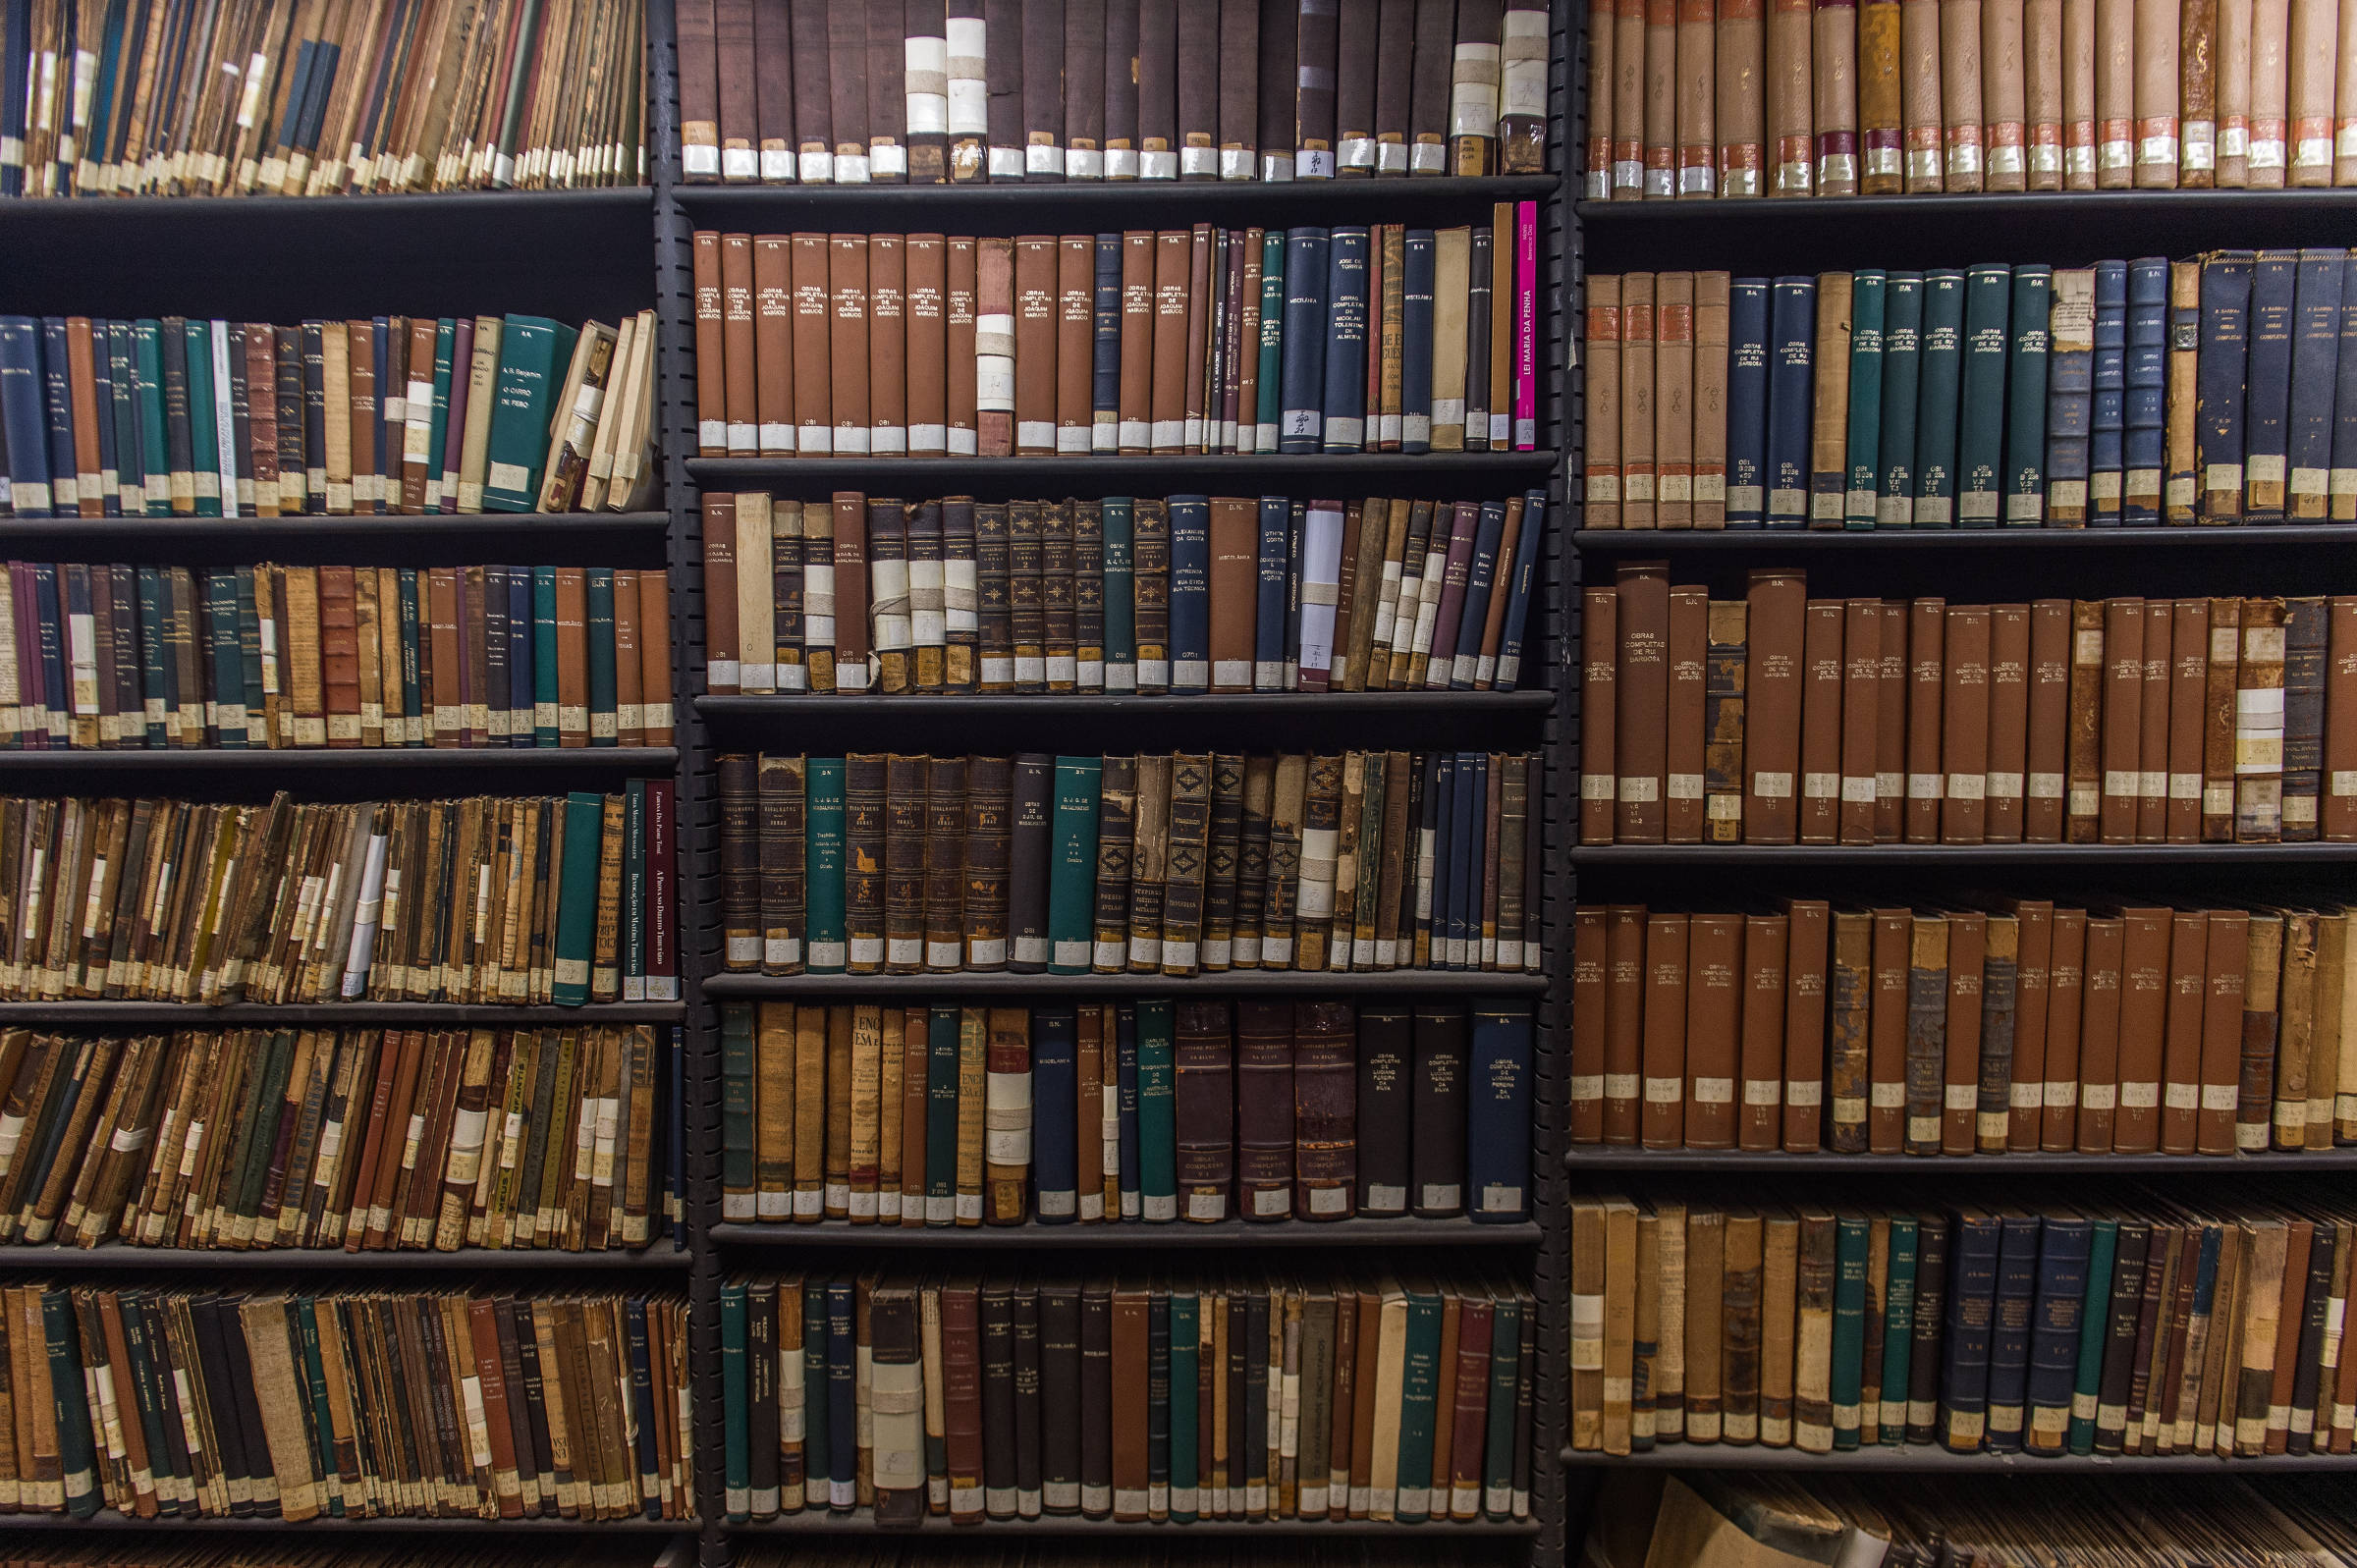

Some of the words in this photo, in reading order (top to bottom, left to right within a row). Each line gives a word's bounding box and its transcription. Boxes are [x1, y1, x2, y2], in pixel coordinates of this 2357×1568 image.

[1523, 320, 1531, 333] DA
[511, 388, 531, 397] CARRO
[513, 1062, 524, 1114] NFANTIS
[498, 1177, 509, 1213] MEUS
